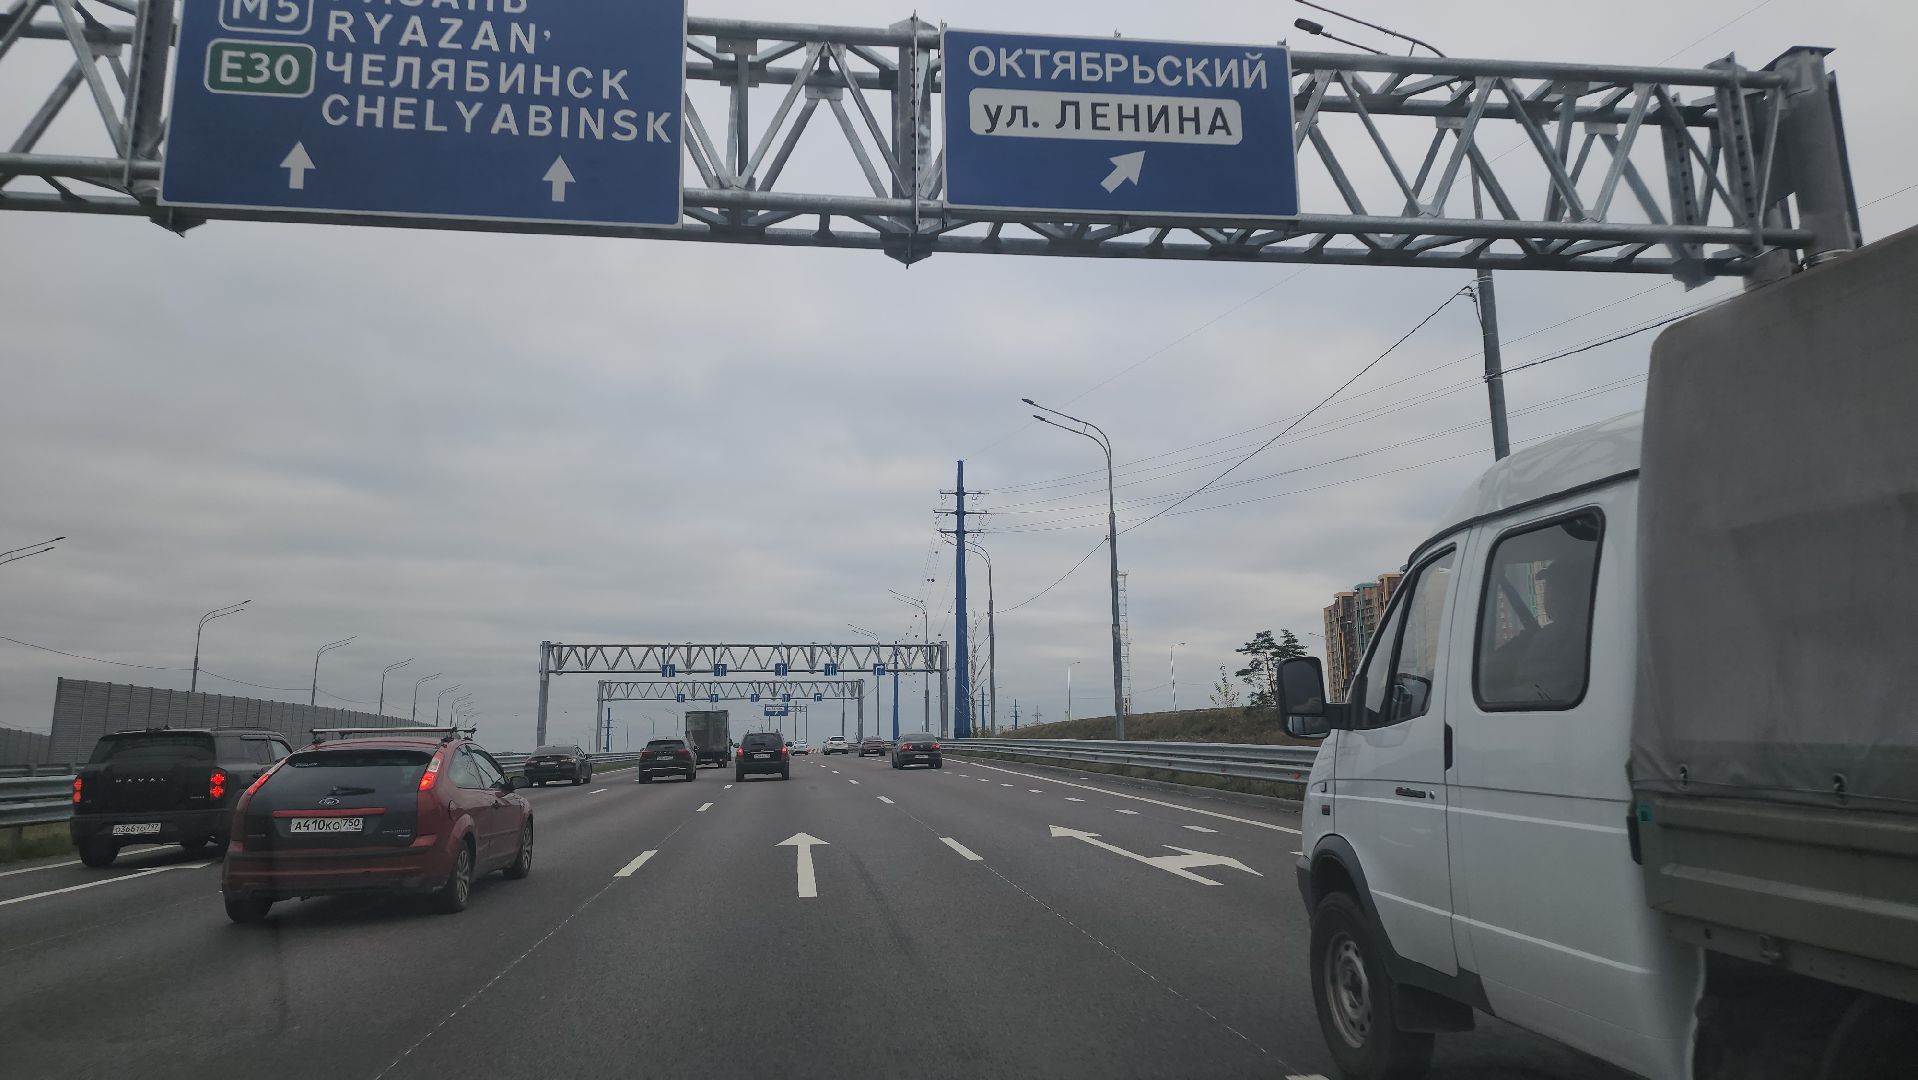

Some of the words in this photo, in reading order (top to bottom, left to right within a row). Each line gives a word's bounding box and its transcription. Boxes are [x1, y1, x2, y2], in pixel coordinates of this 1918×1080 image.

[219, 51, 301, 85] E30
[326, 51, 629, 101] ЧЕЛЯБИНСК
[968, 45, 1268, 89] ОКТЯБРЬСКИЙ
[321, 94, 672, 144] CHELYABINSK
[983, 104, 1040, 134] ул.
[1055, 100, 1233, 136] ЛЕНИНА
